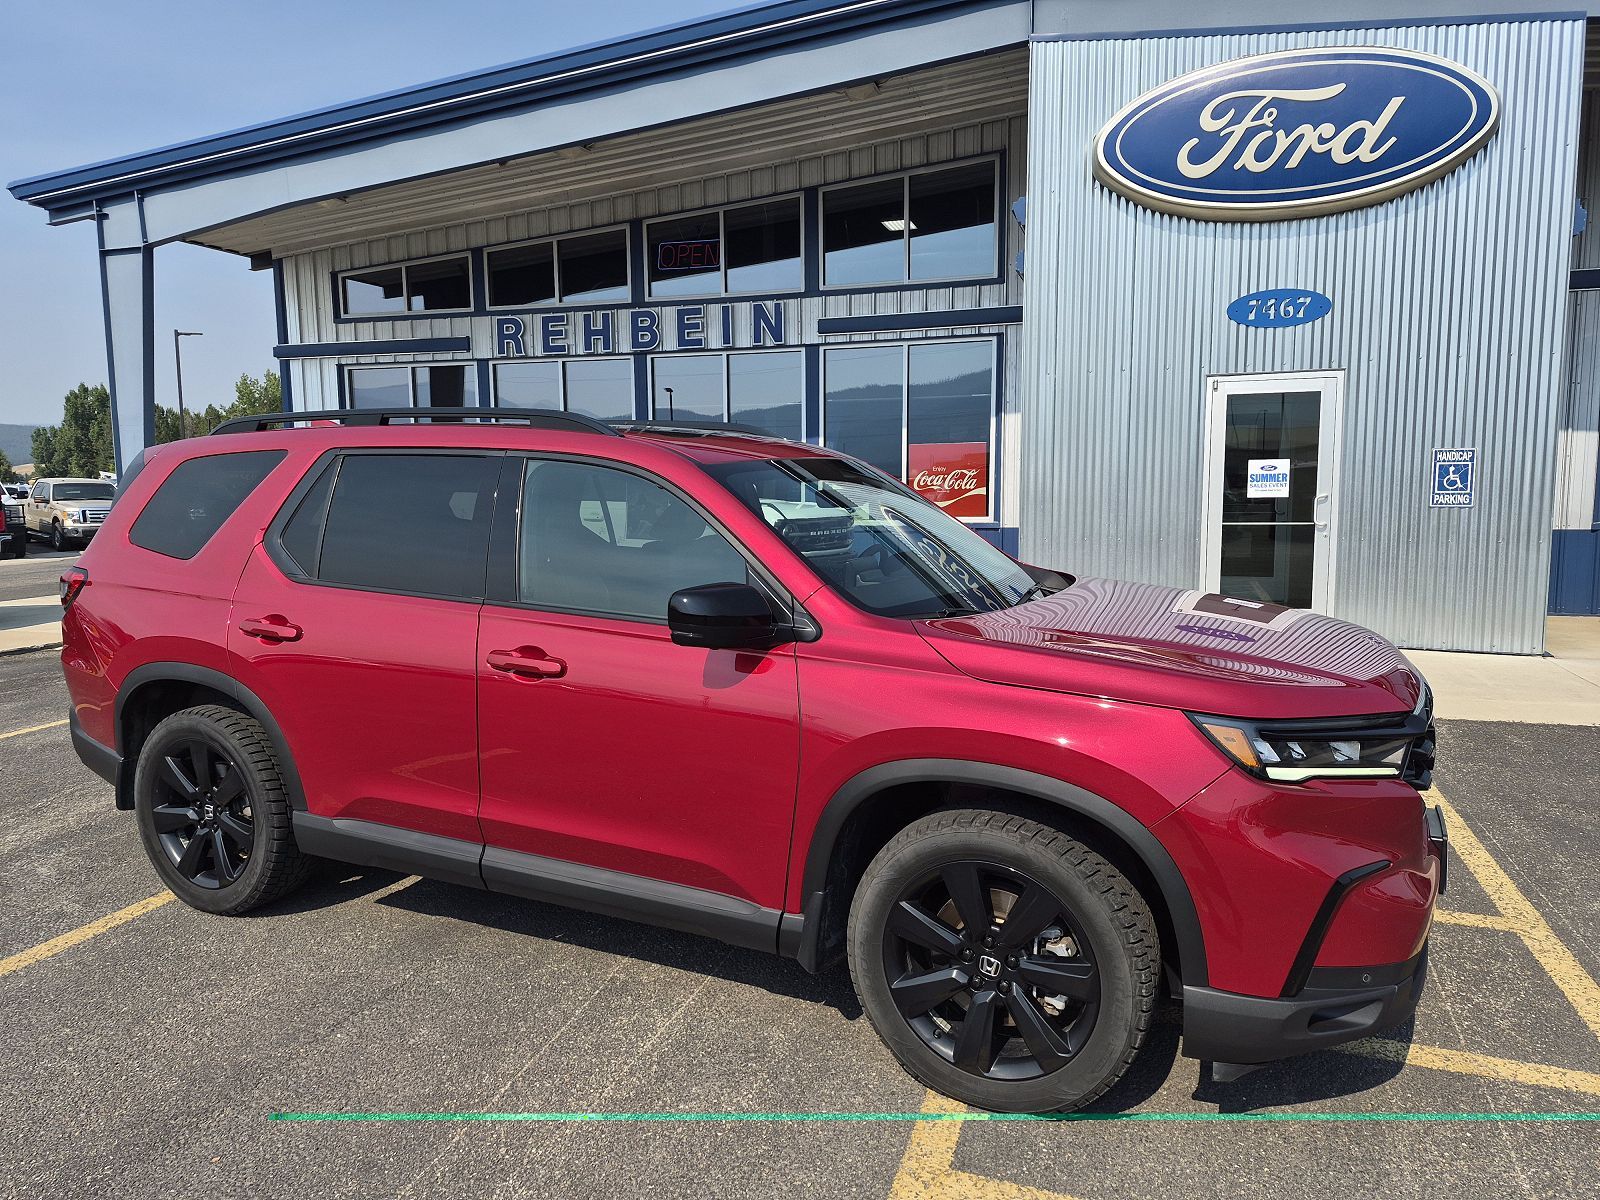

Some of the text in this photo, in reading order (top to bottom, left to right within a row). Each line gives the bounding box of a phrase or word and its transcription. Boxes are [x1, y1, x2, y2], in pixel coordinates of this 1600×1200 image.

[1176, 82, 1406, 179] Ford
[660, 243, 720, 268] OPEN
[1247, 296, 1312, 320] 7467
[496, 300, 785, 358] REHBEIN
[1437, 452, 1472, 460] HANDICAP
[913, 468, 981, 491] Coca-Cola
[1250, 473, 1288, 482] SUMMER
[1434, 495, 1469, 504] PARKING
